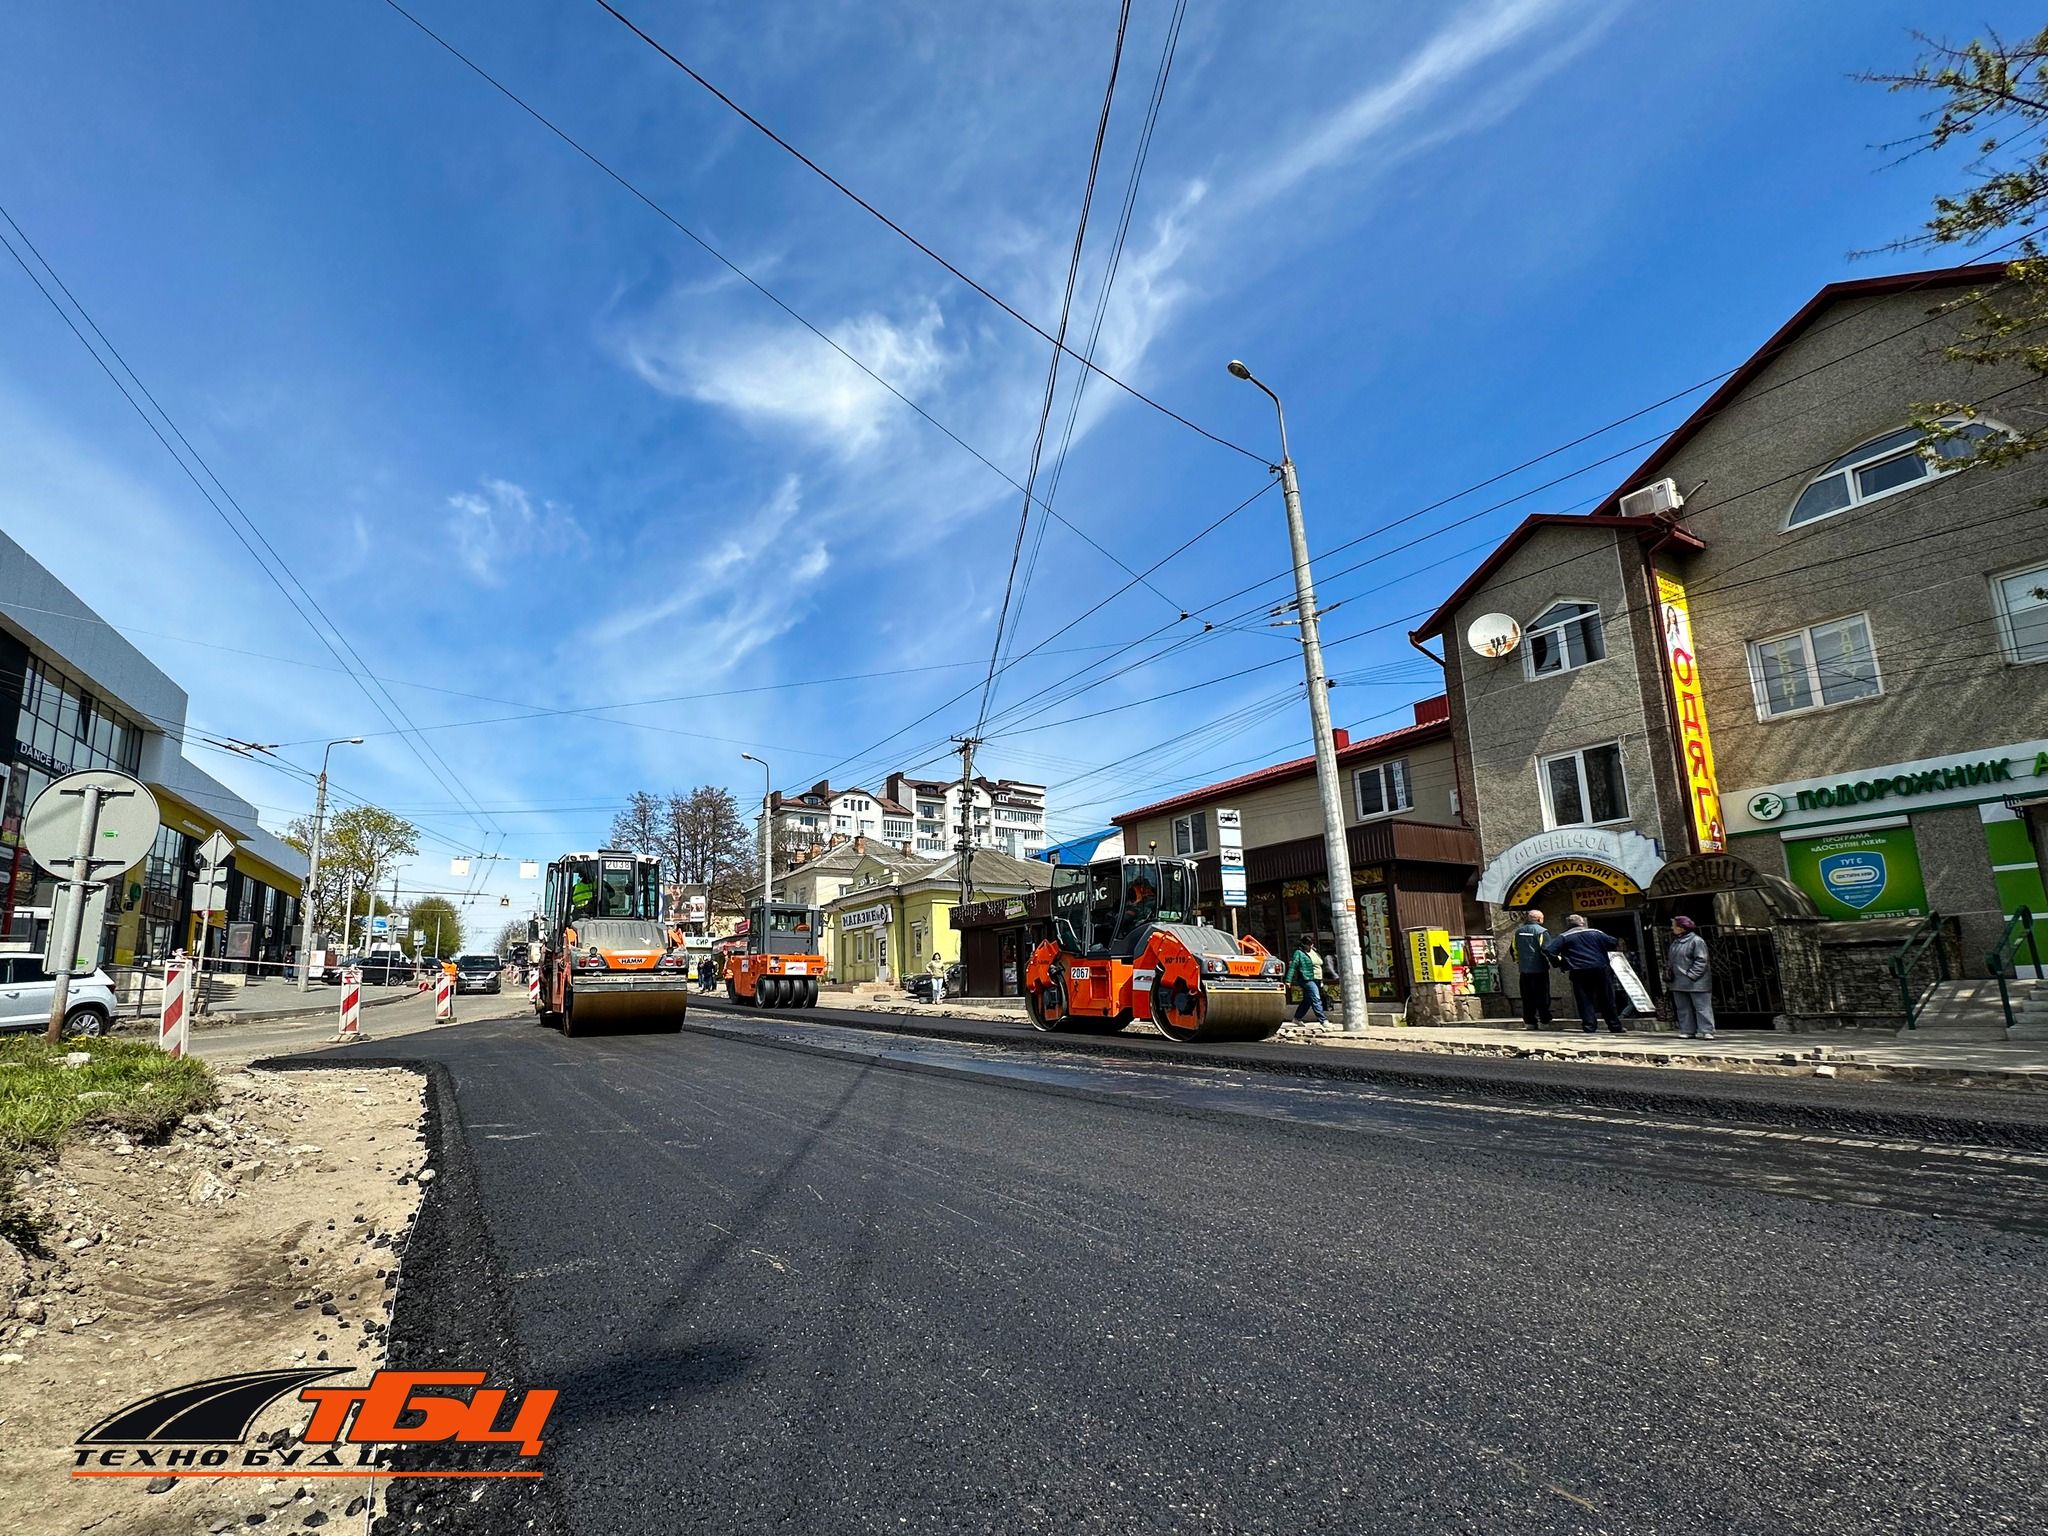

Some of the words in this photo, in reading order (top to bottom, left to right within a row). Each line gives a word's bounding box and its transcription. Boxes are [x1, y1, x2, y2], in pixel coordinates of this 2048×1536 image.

[1673, 647, 1712, 824] ОДЯГ
[20, 743, 52, 767] DANCE
[53, 758, 77, 774] MOD
[1796, 758, 2014, 811] ПОДОРОЖНИК
[1711, 821, 1720, 838] 2
[1823, 833, 1871, 843] ПРОГРАМА
[607, 861, 630, 869] 2038
[1840, 858, 1855, 866] ТУТ
[1528, 863, 1612, 889] ЗООМАГАЗИН
[1580, 897, 1617, 907] ОДЯГУ
[1072, 967, 1089, 978] 2067
[1235, 964, 1256, 973] HAMM
